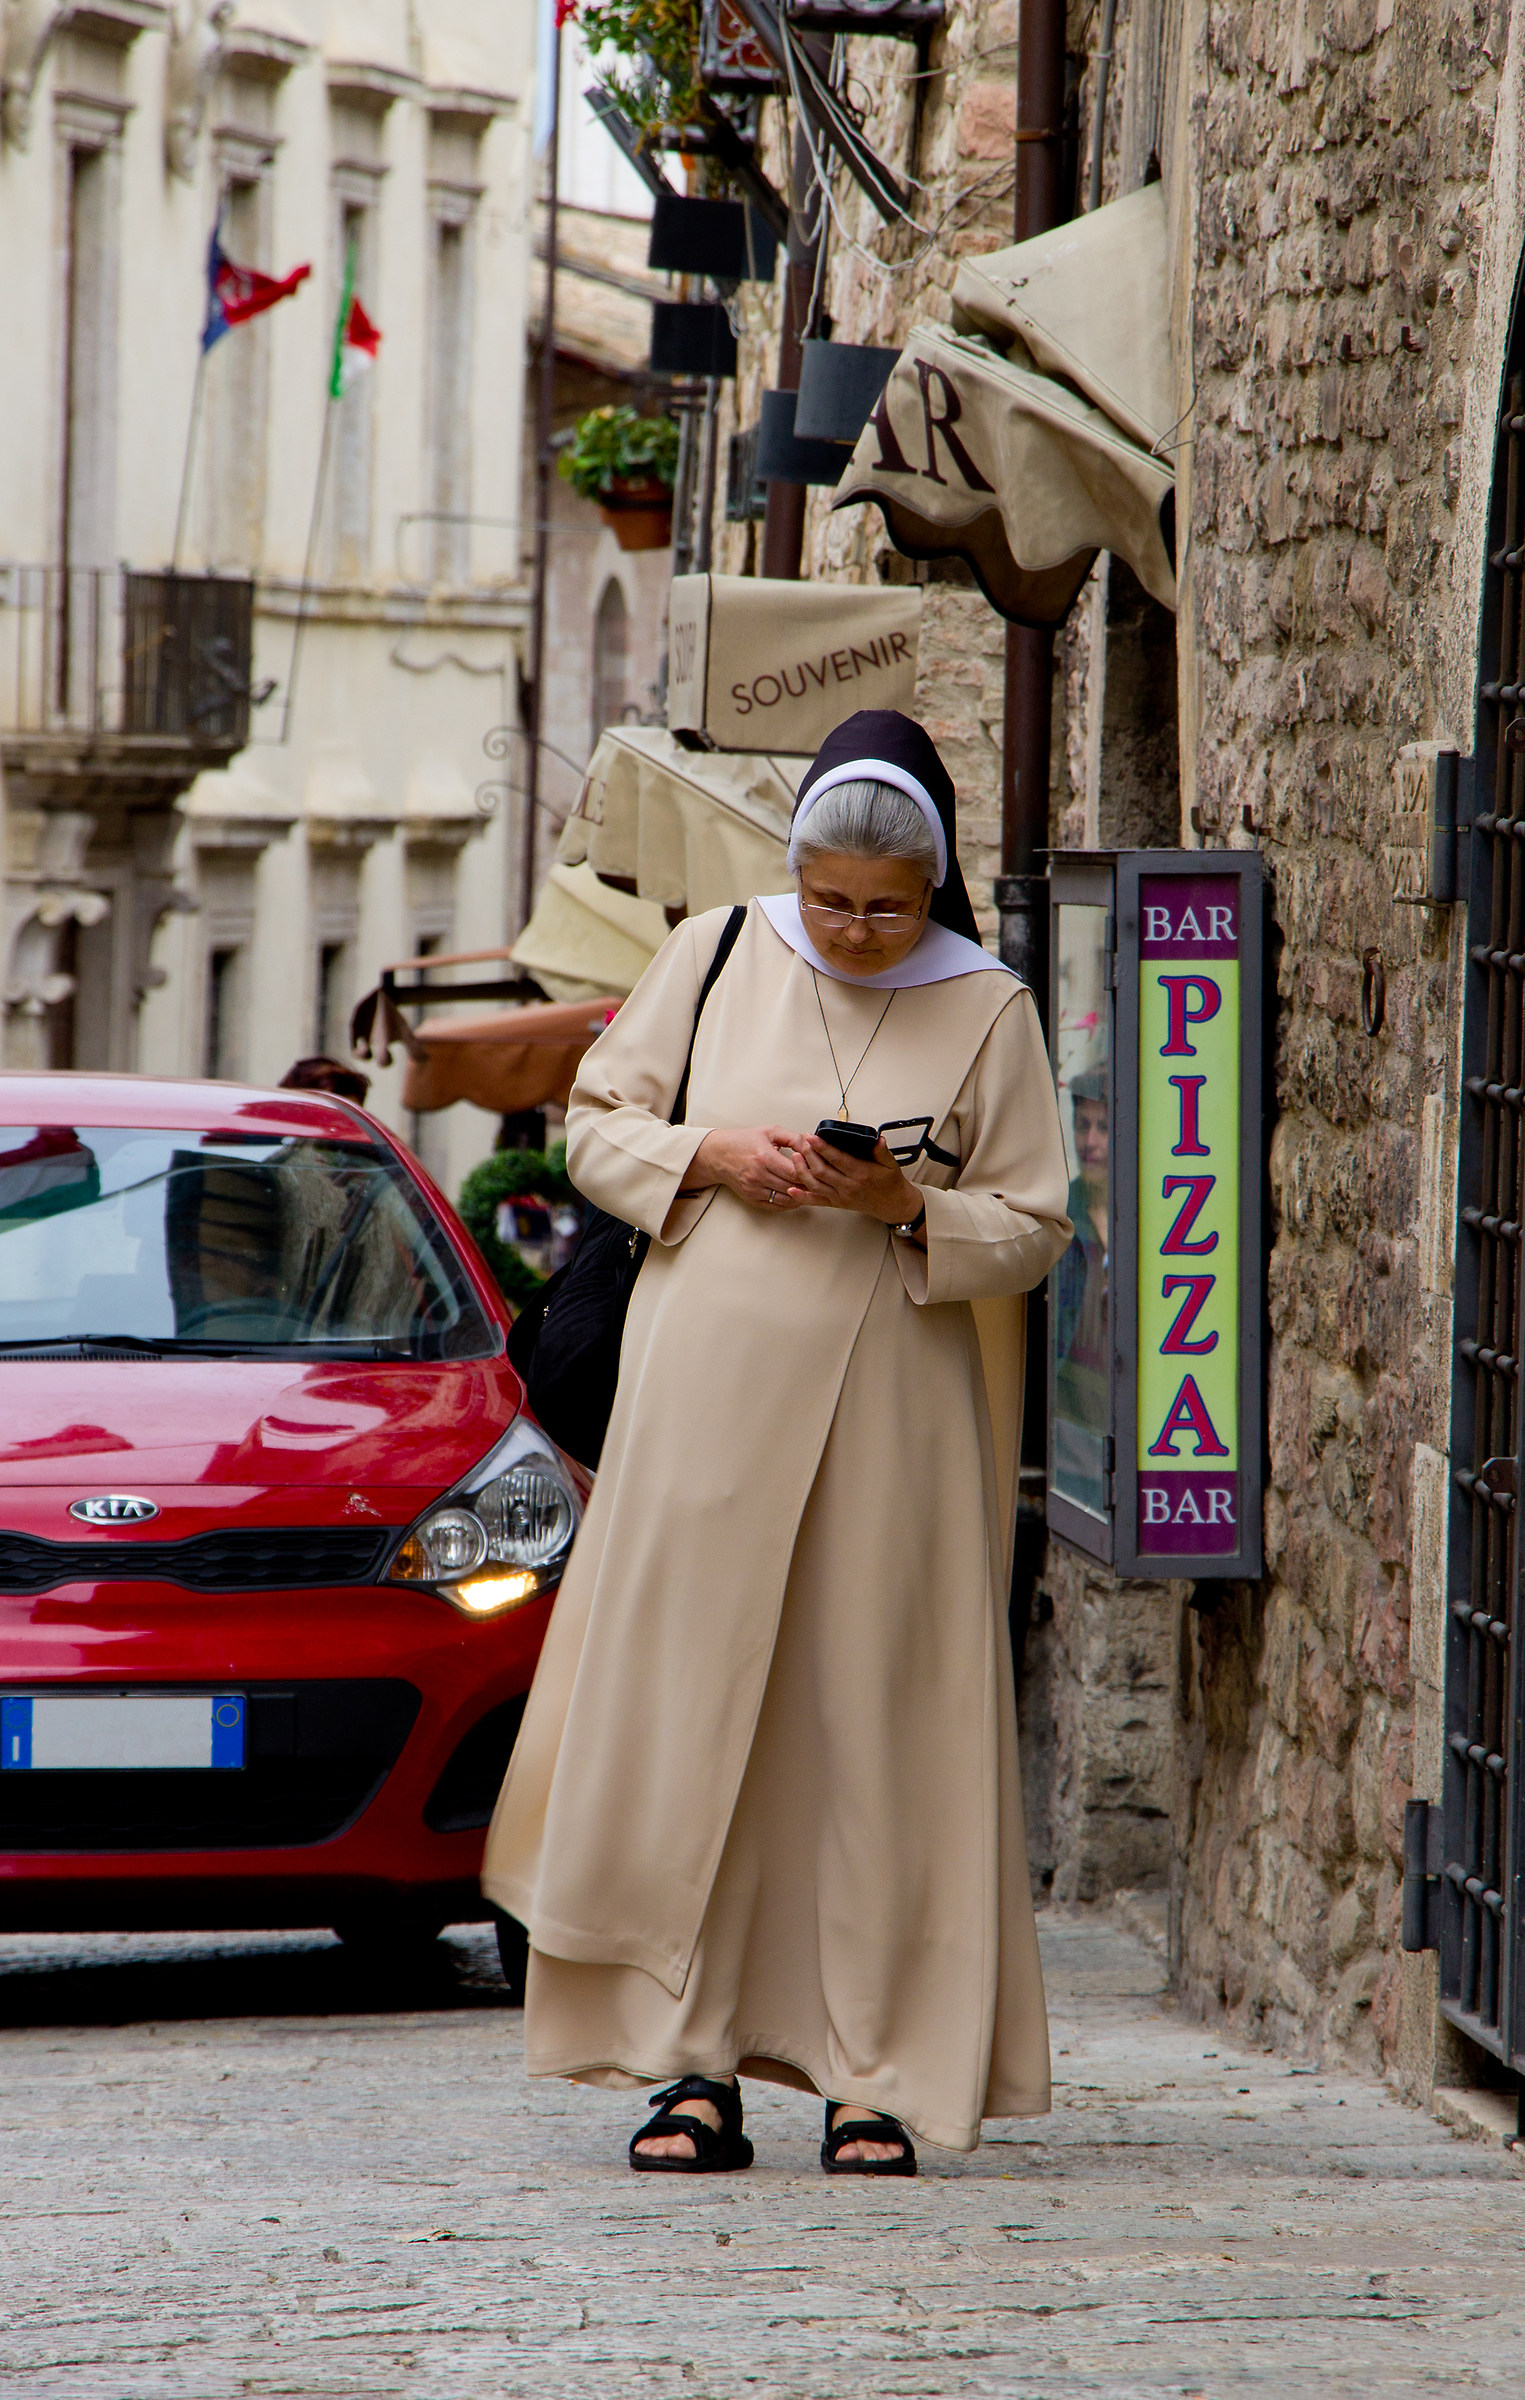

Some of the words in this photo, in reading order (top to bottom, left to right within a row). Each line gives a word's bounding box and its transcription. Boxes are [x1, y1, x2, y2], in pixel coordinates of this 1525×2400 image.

[731, 632, 913, 715] SOUVENIR
[1143, 906, 1238, 941] BAR
[1148, 974, 1230, 1457] PIZZA
[85, 1499, 144, 1518] KIA
[1141, 1488, 1237, 1524] BAR
